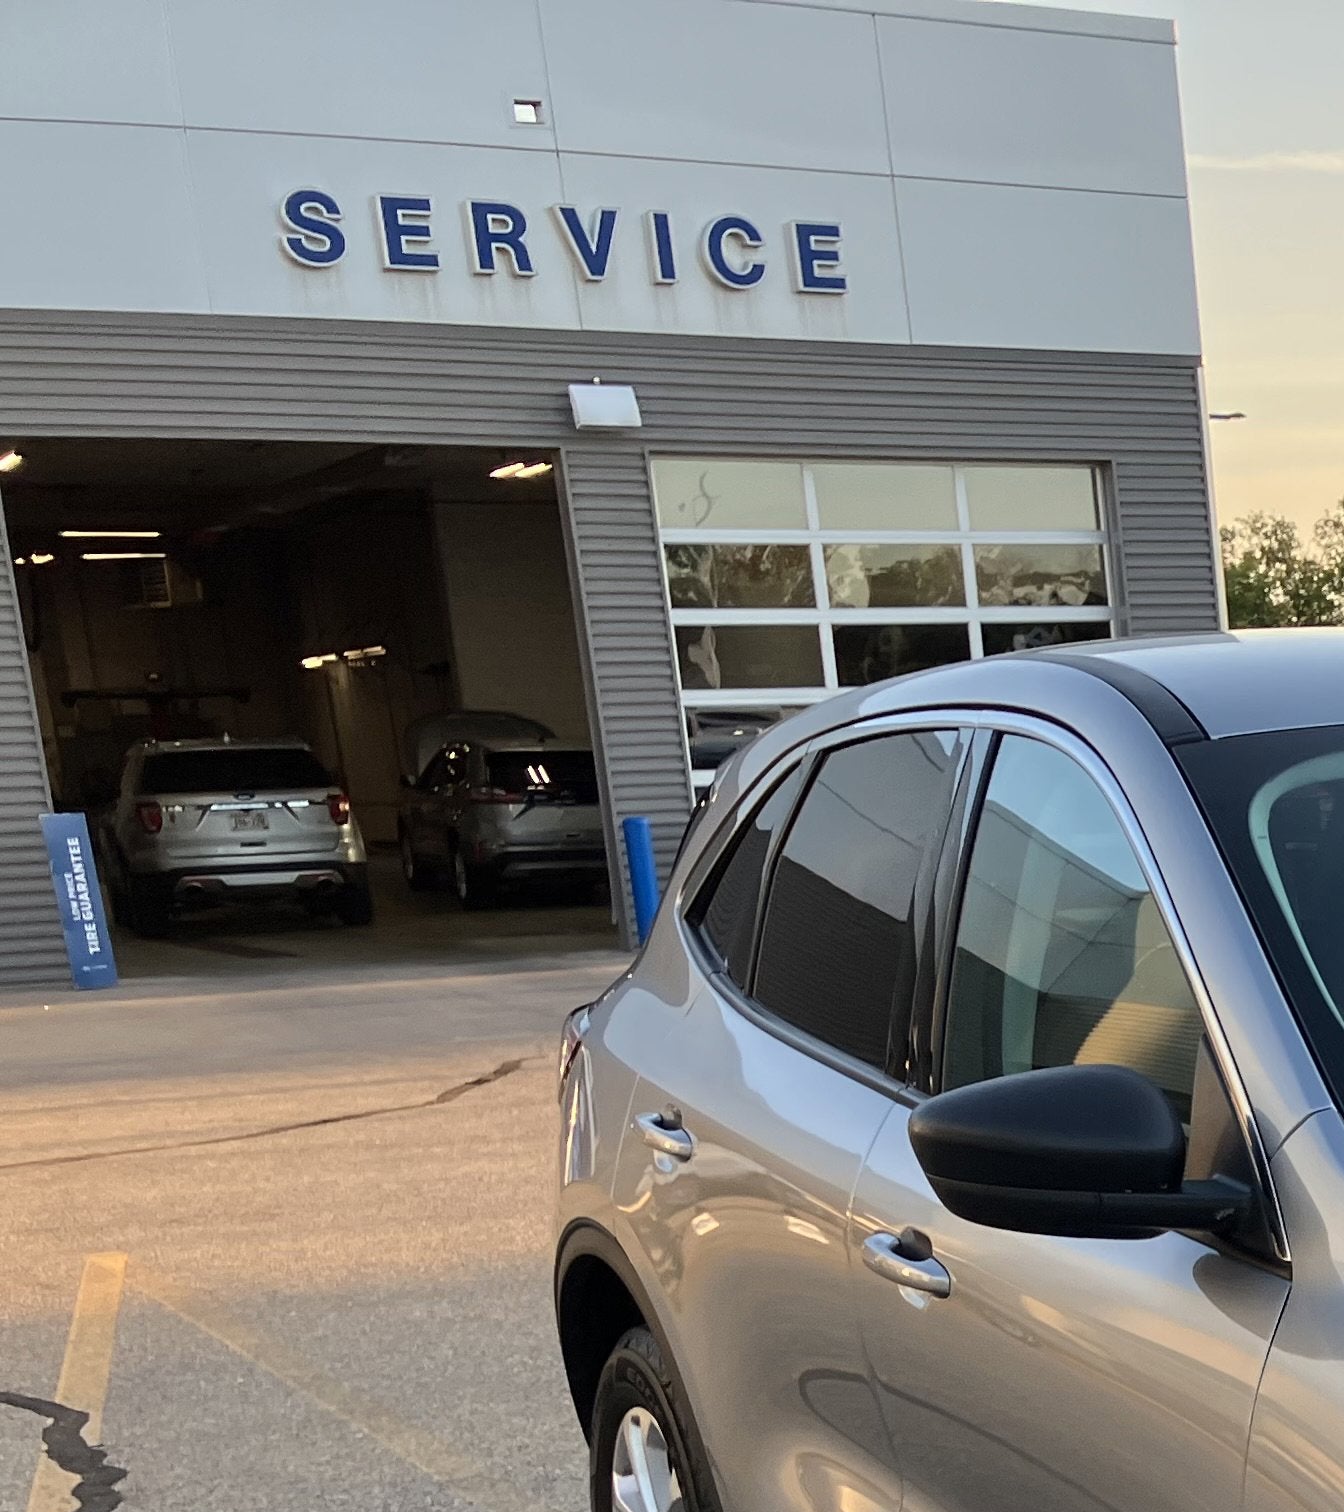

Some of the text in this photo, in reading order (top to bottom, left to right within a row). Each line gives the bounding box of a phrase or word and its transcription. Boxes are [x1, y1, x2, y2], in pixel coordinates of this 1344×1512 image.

[282, 188, 848, 294] SERVICE
[67, 836, 95, 920] GUARANTEE
[84, 922, 101, 955] TIRE
